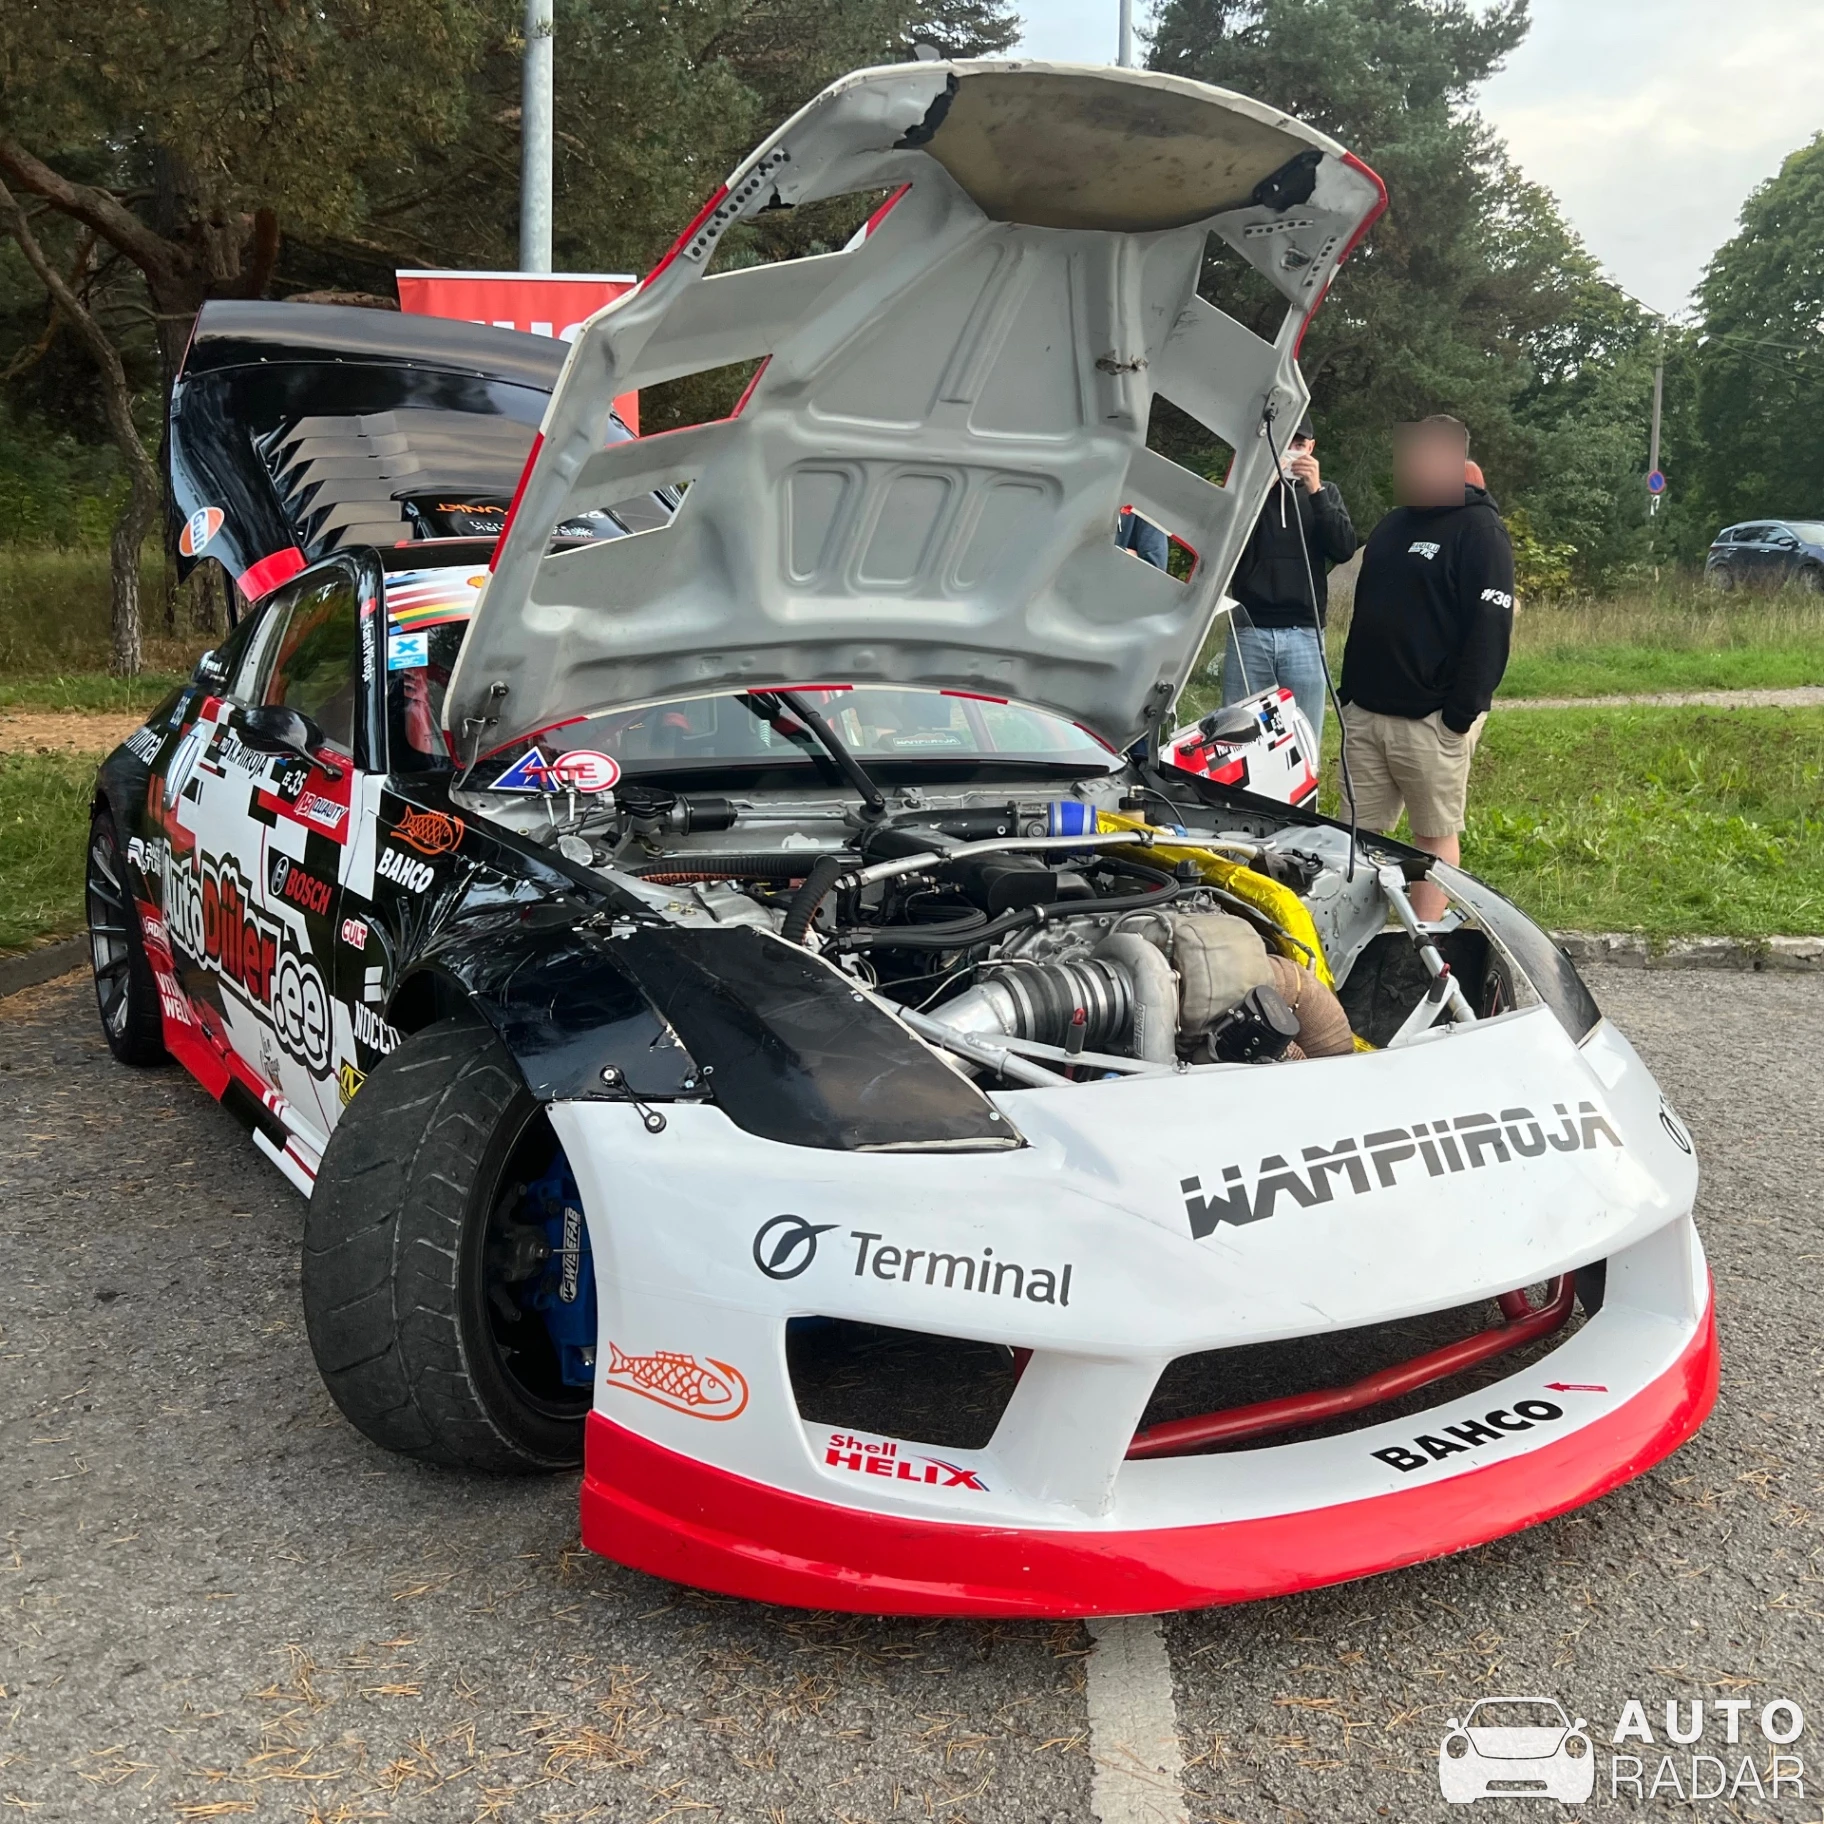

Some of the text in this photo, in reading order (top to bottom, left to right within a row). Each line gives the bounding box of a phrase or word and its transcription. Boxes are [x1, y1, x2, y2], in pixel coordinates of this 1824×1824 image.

[1481, 589, 1512, 609] #36
[287, 769, 308, 796] 35
[285, 867, 333, 916] BOSCH
[376, 847, 435, 894] BAHCO
[342, 918, 368, 950] CULT
[1180, 1101, 1624, 1240] WAMPIIROJA
[850, 1231, 1073, 1308] Terminal
[828, 1433, 897, 1457] Shell
[1369, 1399, 1564, 1473] BAHCO
[825, 1446, 988, 1492] HELIX
